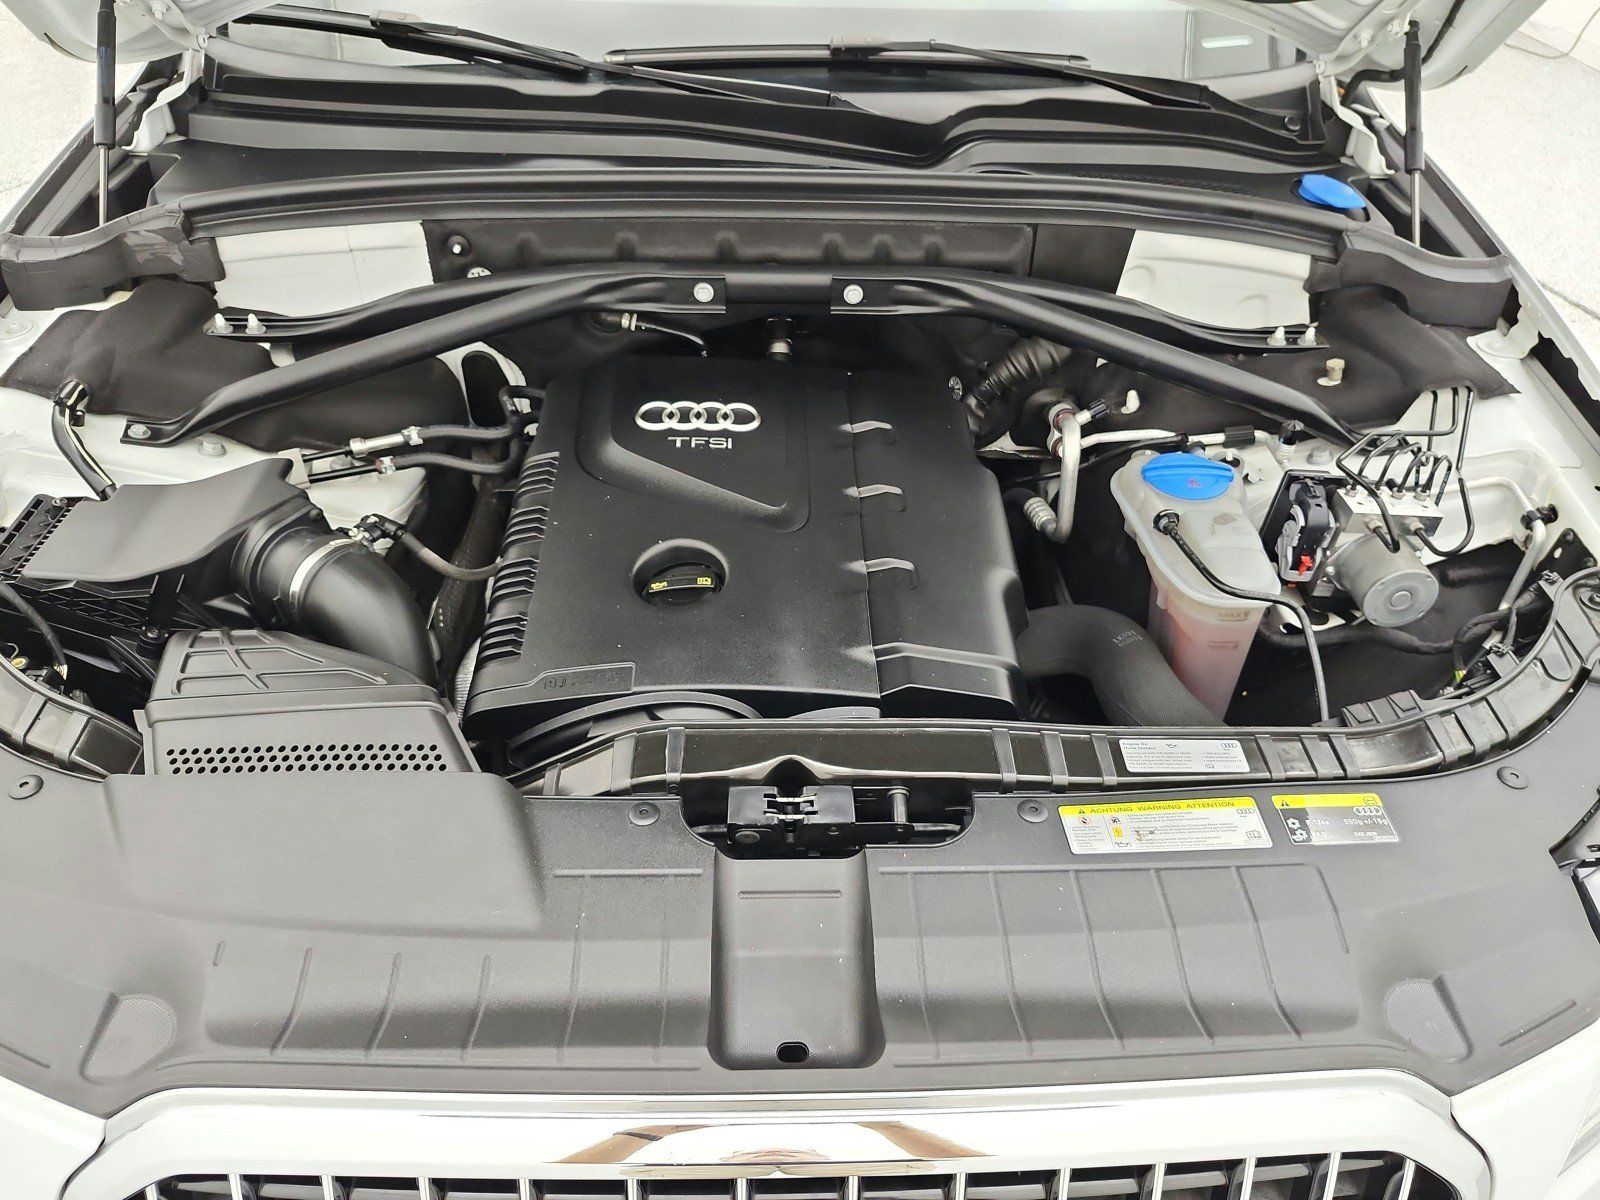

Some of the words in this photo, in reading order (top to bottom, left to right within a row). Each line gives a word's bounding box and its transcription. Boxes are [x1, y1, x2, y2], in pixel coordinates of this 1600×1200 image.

[667, 436, 733, 450] TFSI
[1090, 805, 1133, 814] ACHTUNG
[1137, 802, 1181, 811] WARNING
[1186, 800, 1235, 810] ATTENTION
